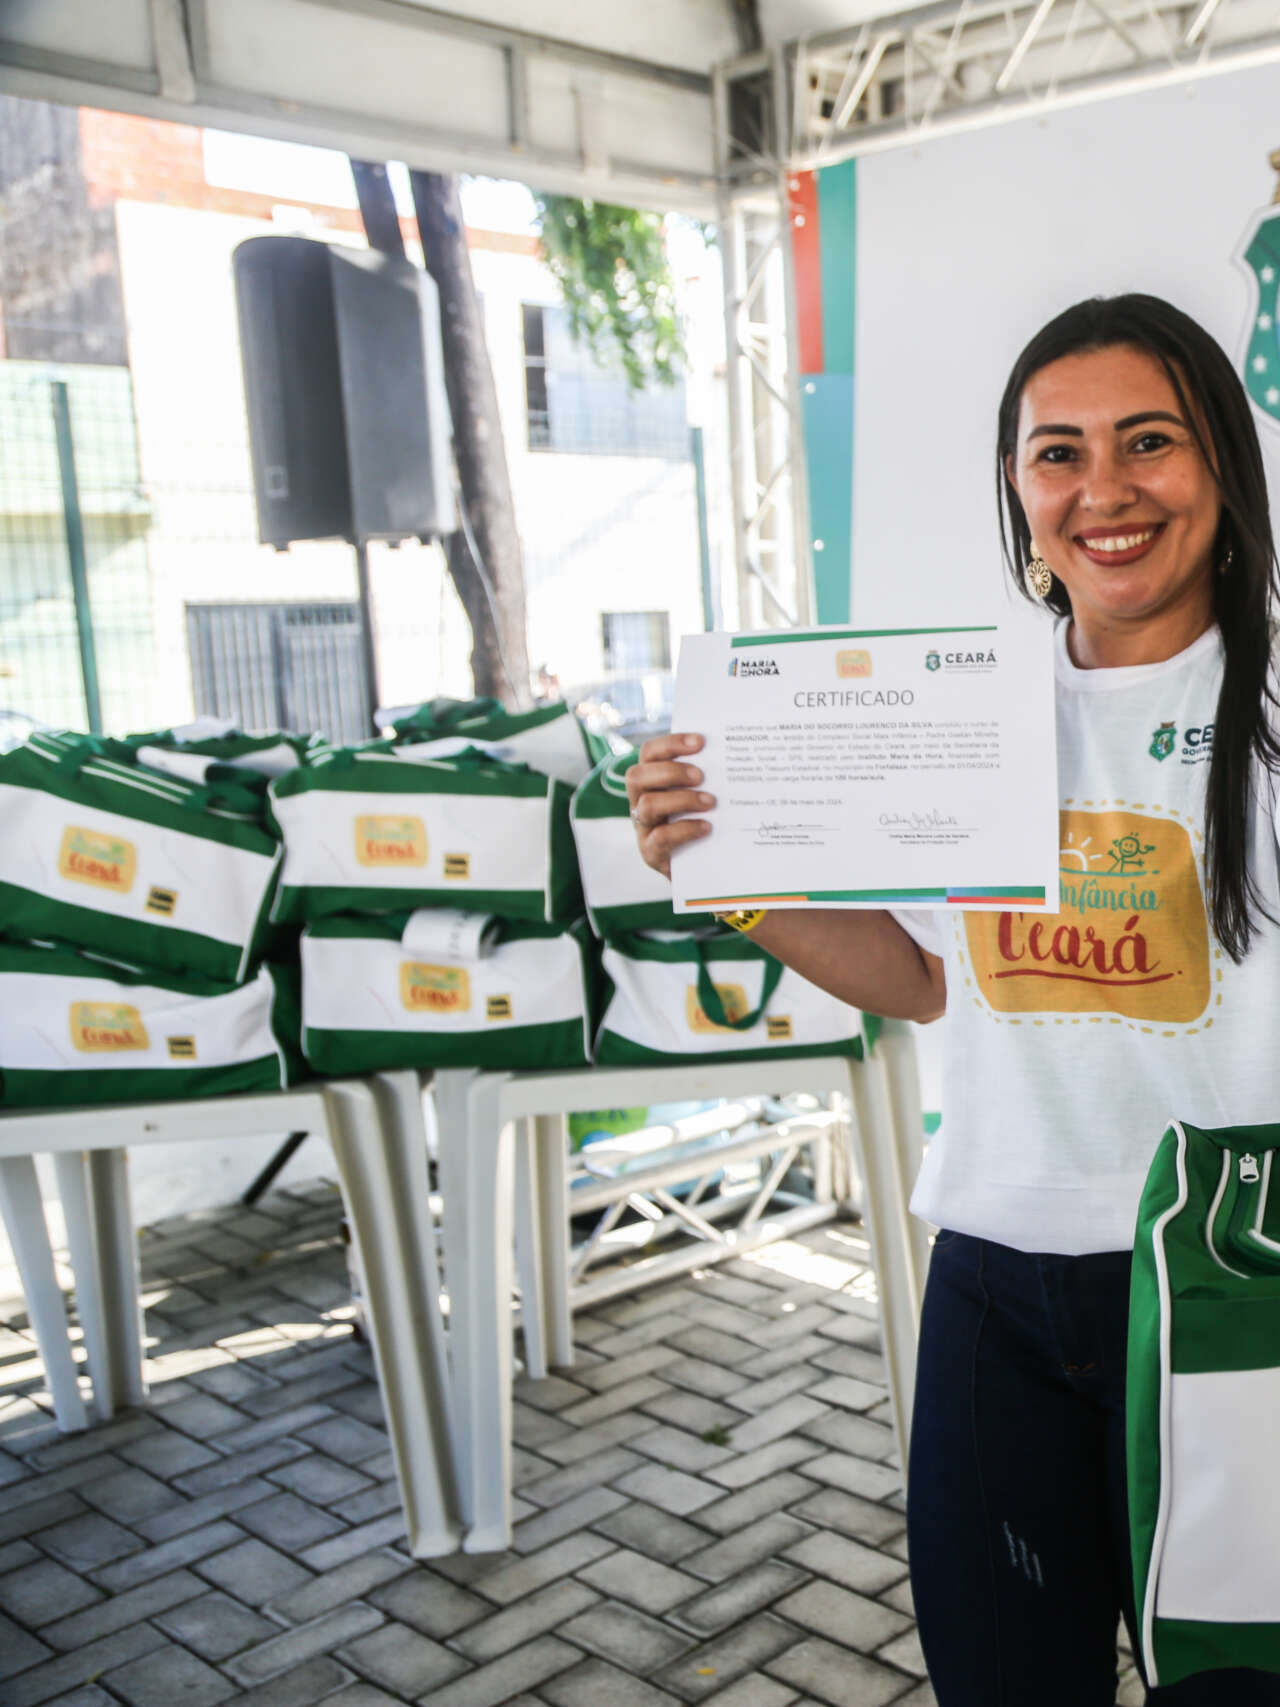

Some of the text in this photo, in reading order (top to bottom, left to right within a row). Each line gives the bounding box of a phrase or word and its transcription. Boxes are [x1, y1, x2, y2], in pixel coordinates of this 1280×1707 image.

[740, 659, 777, 668] MARIA
[945, 647, 997, 664] CEARÁ
[748, 667, 780, 676] HORA
[793, 688, 915, 709] CERTIFICADO
[998, 911, 1160, 974] Ceará
